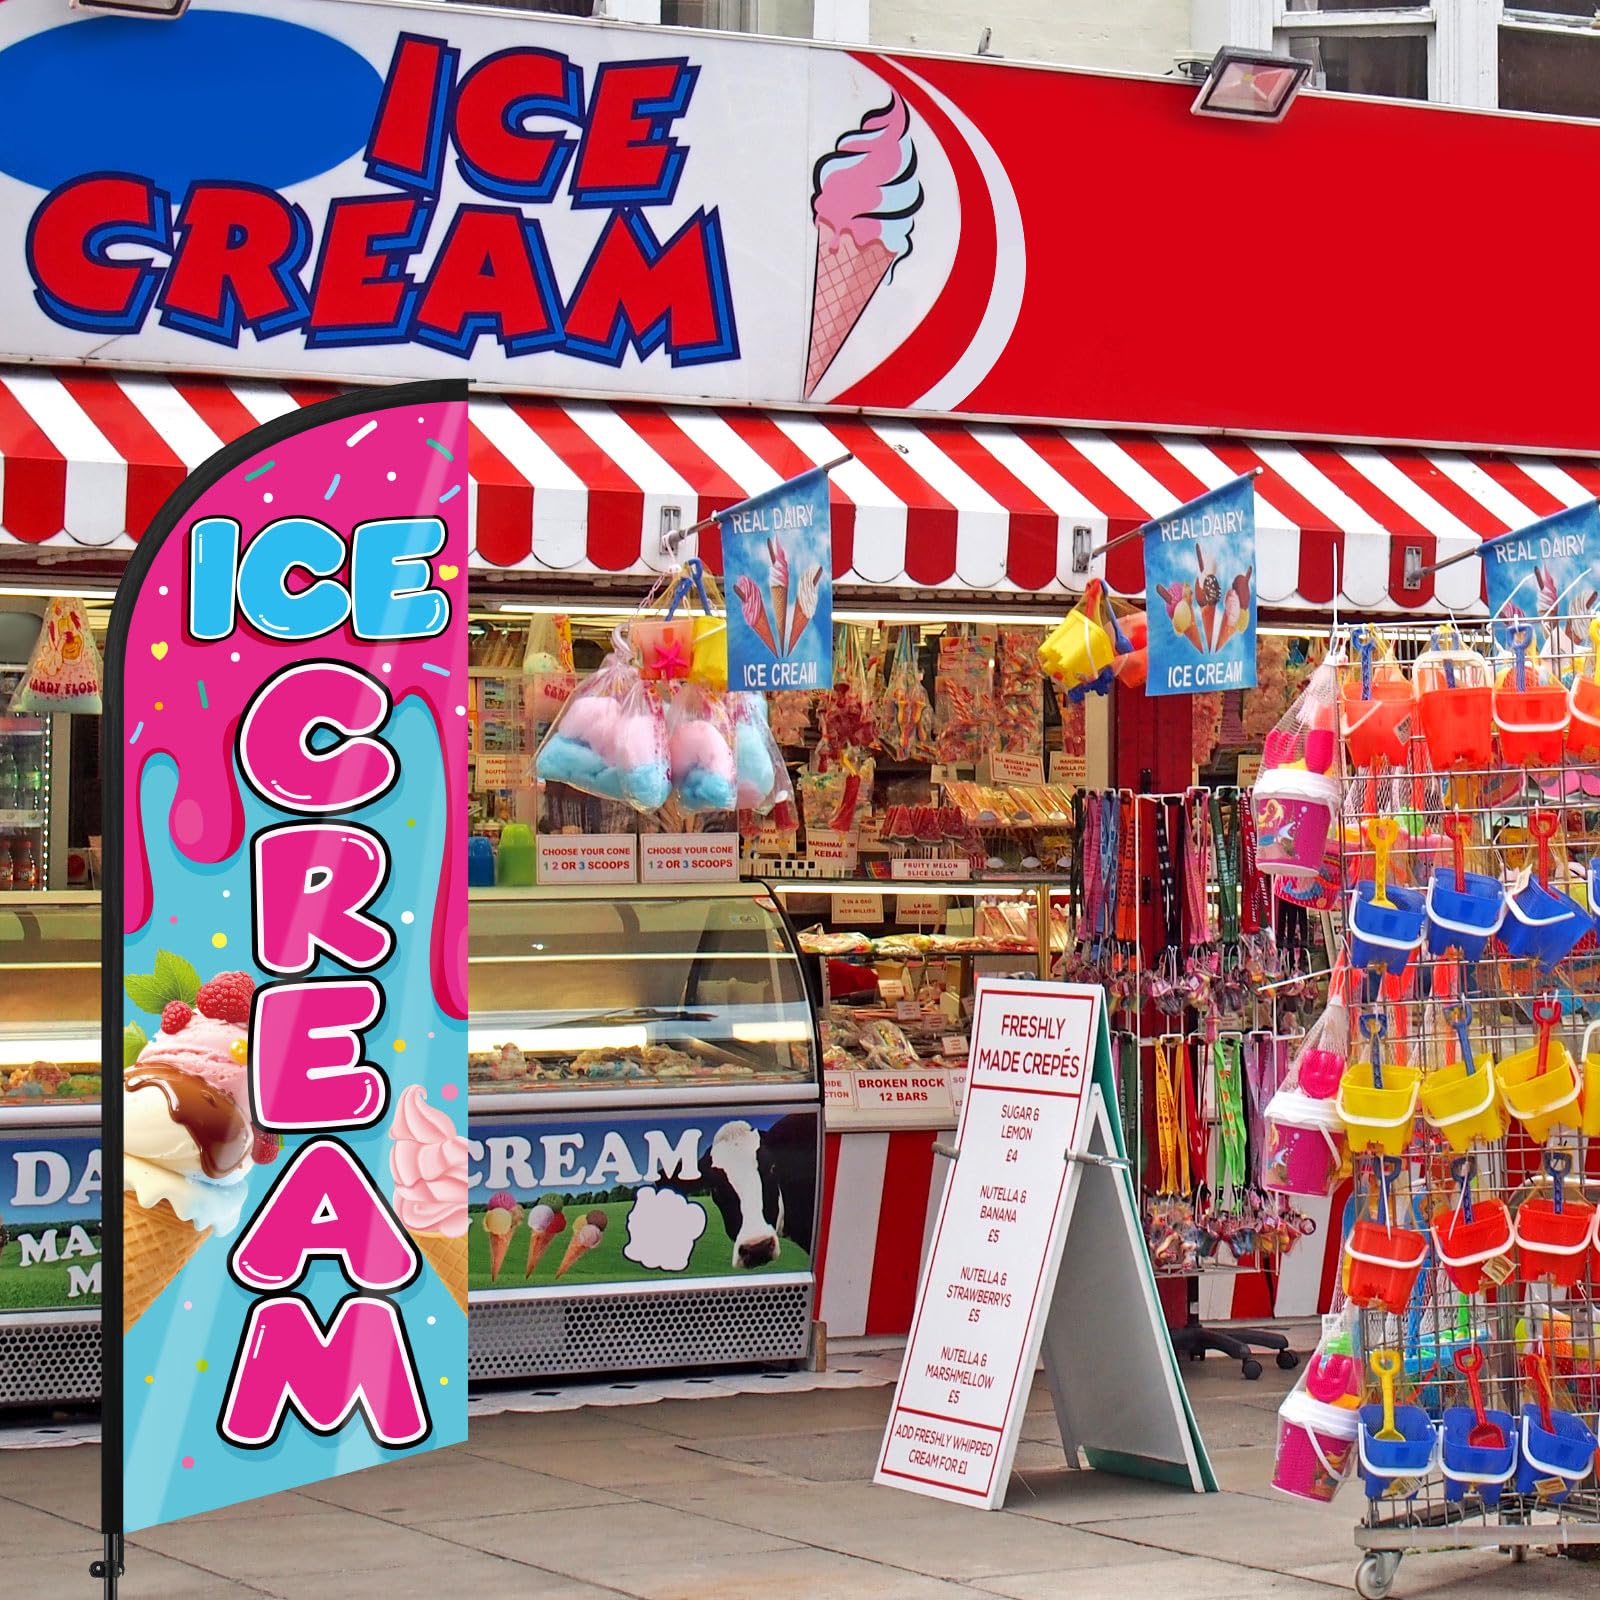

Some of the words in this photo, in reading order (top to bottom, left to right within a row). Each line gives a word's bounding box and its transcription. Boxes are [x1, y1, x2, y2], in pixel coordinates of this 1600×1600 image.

[364, 30, 701, 209] ICE
[25, 170, 741, 369] CREAM
[731, 510, 769, 534] REAL
[772, 504, 815, 530] DAIRY
[1159, 516, 1197, 542] REAL
[1201, 510, 1245, 537] DAIRY
[1493, 539, 1537, 563] REAL
[1540, 534, 1586, 559] DAIRY
[187, 514, 453, 643] ICE
[743, 663, 768, 687] ICE
[771, 661, 817, 686] CREAM
[1167, 664, 1193, 688] ICE
[1195, 660, 1243, 687] CREAM
[543, 848, 578, 856] CHOOSE
[606, 847, 631, 855] CONE
[684, 846, 708, 854] YOUR
[543, 862, 548, 870] 1
[552, 862, 559, 870] 2
[561, 861, 576, 870] OR
[579, 861, 585, 870] 3
[588, 861, 630, 870] SCOOPS
[648, 861, 653, 869] 1
[657, 861, 664, 869] 2
[665, 860, 680, 869] OR
[683, 860, 689, 868] 3
[691, 859, 733, 868] SCOOPS
[1001, 1014, 1066, 1040] FRESHLY
[216, 657, 433, 1451] CREAM
[978, 1048, 1021, 1073] MADE
[1022, 1047, 1080, 1079] CREPÉS
[858, 1078, 908, 1088] BROKEN
[911, 1078, 945, 1088] ROCK
[879, 1092, 893, 1101] 12
[896, 1092, 928, 1101] BARS
[1000, 1104, 1032, 1121] SUGAR
[1033, 1107, 1040, 1121] &
[1001, 1125, 1033, 1141] LEMON
[1005, 1149, 1018, 1163] £4
[10, 1149, 102, 1206] DA
[980, 1184, 1018, 1202] NUTELLA
[1020, 1190, 1027, 1203] &
[980, 1205, 1017, 1223] BANANA
[17, 1222, 102, 1267] MA
[987, 1229, 1000, 1243] £5
[960, 1266, 999, 1285] NUTELLA
[1000, 1272, 1007, 1286] &
[946, 1284, 1012, 1308] STRAWBERRYS
[968, 1308, 980, 1322] £5
[940, 1346, 980, 1366] NUTELLA
[980, 1353, 987, 1367] &
[925, 1364, 995, 1389] MARSHMELLOW
[947, 1389, 960, 1404] £5
[894, 1423, 915, 1439] ADD
[914, 1427, 952, 1448] FRESHLY
[952, 1435, 993, 1457] WHIPPED
[908, 1448, 939, 1467] CREAM
[938, 1455, 958, 1472] FOR
[957, 1459, 968, 1475] £1
